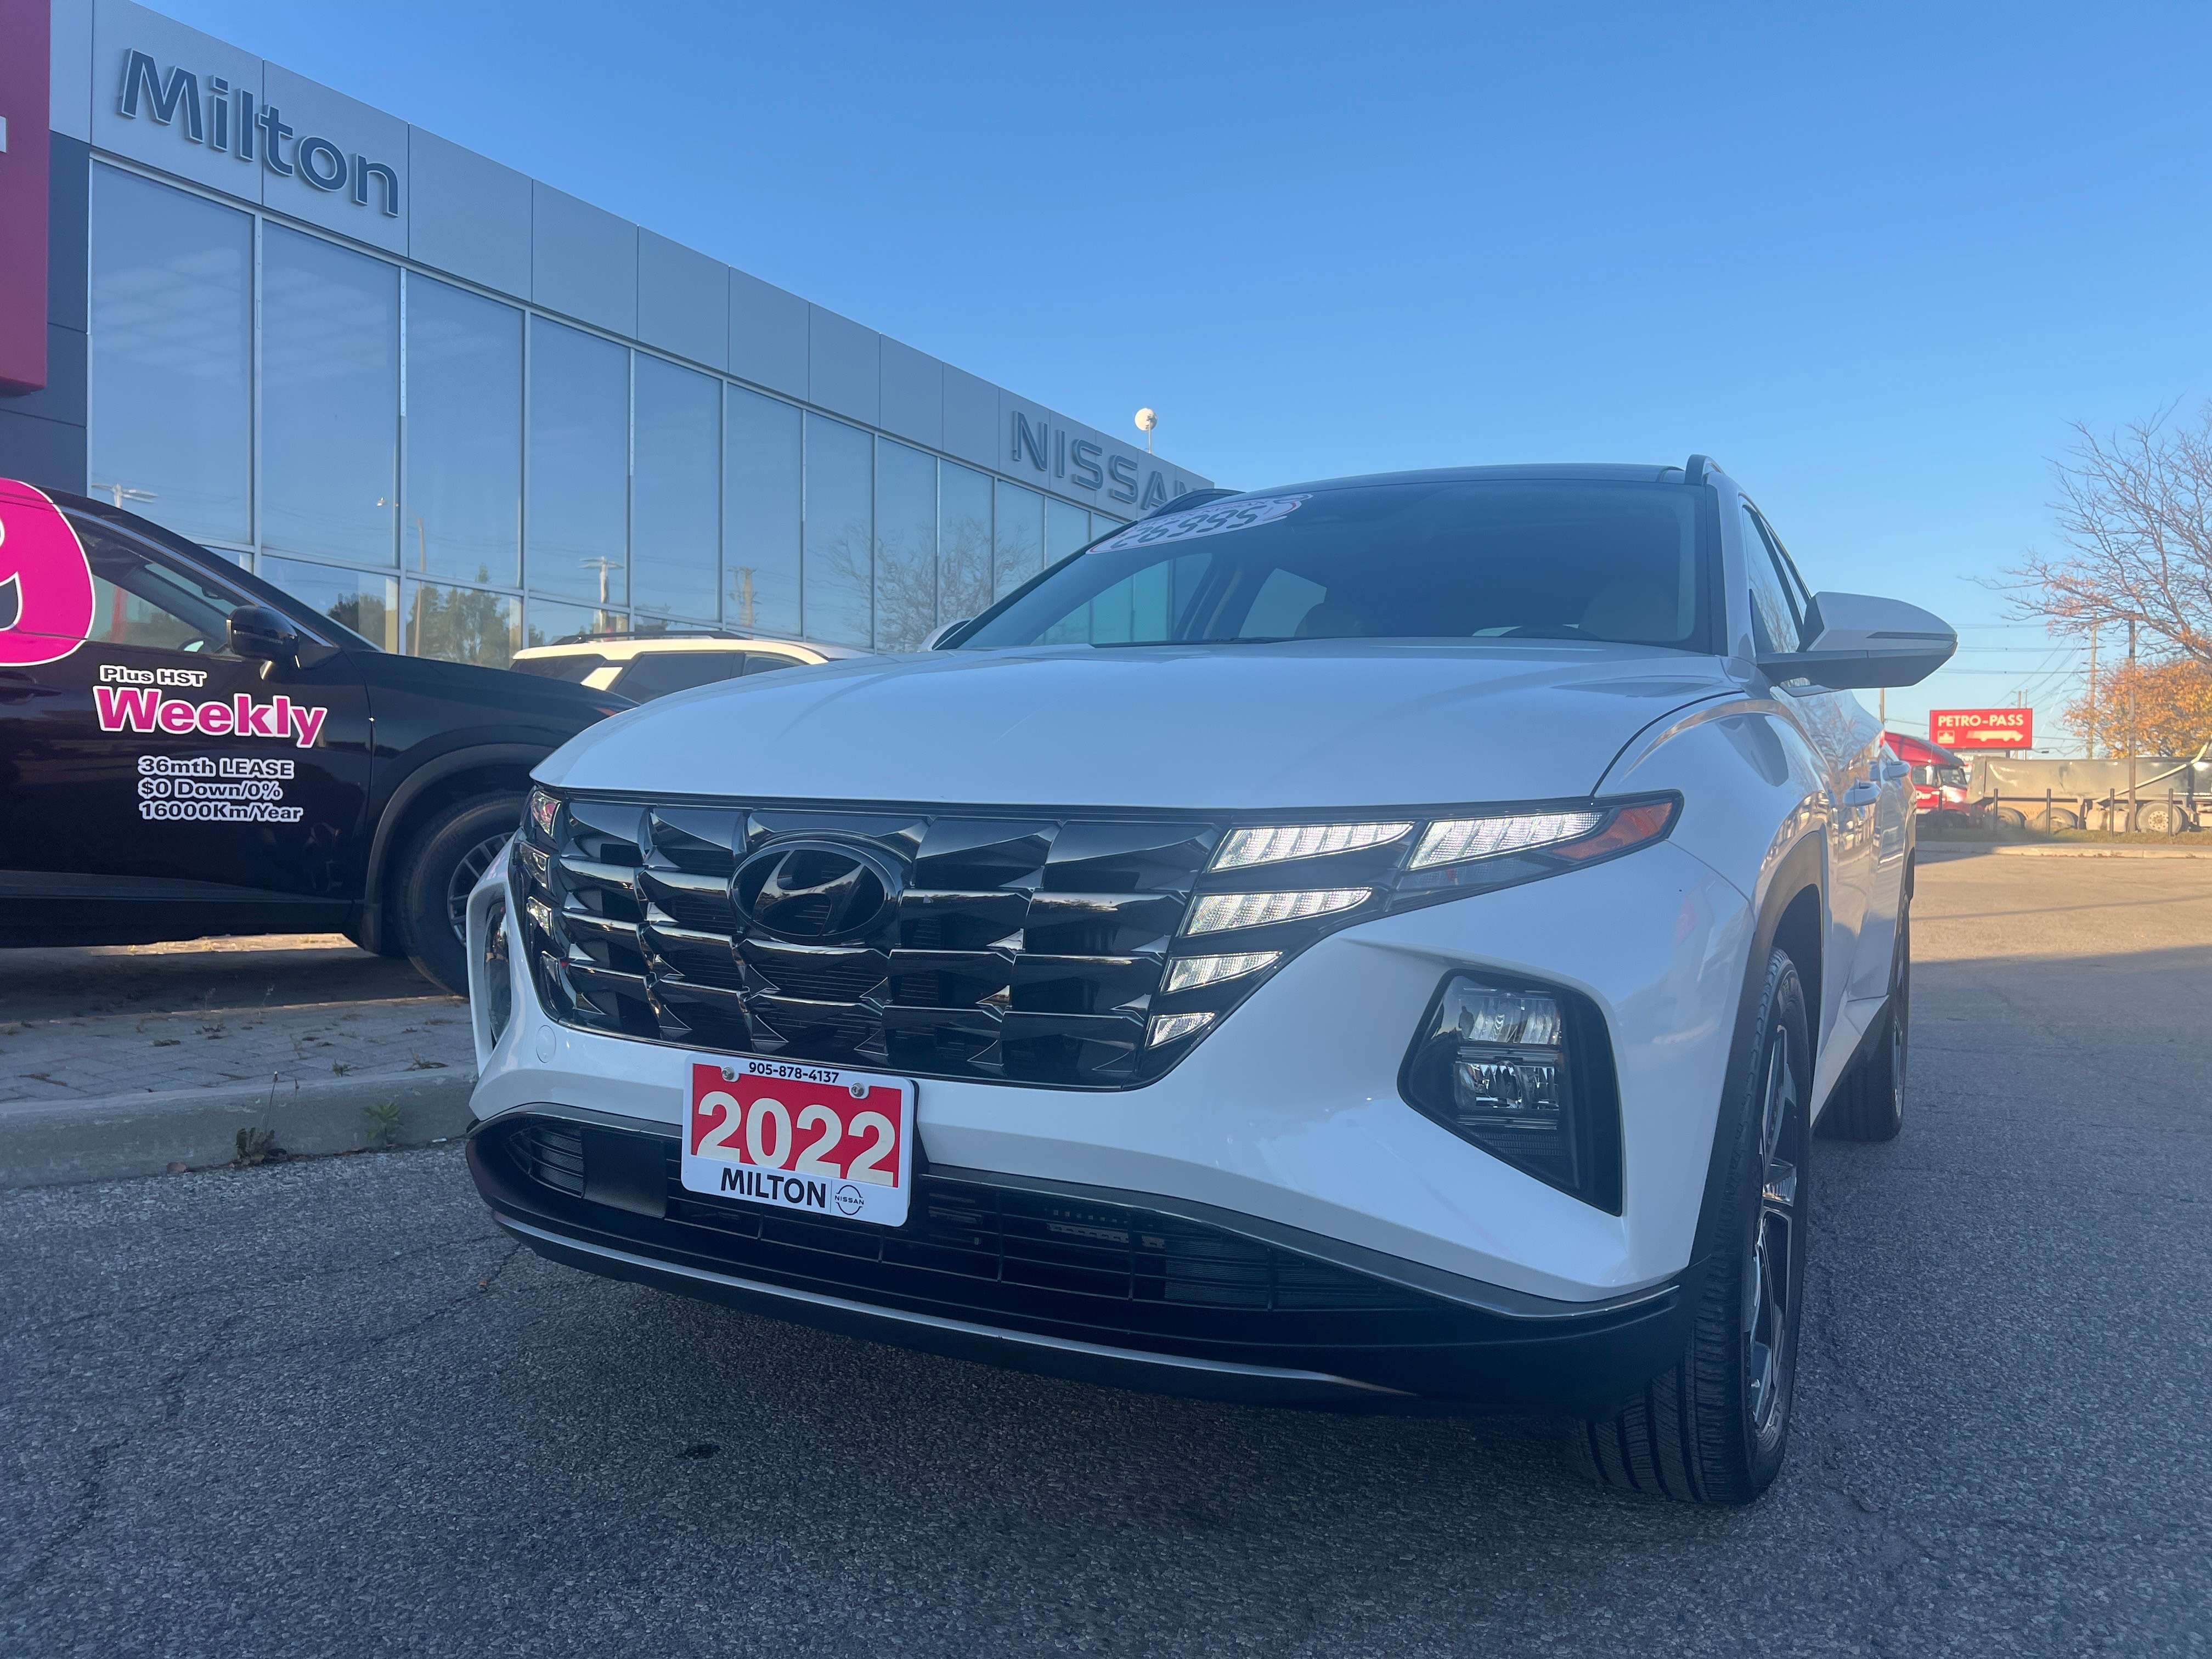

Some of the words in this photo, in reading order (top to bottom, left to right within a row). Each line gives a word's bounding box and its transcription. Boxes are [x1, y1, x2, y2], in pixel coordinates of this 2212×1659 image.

[117, 48, 399, 218] Milton
[99, 665, 155, 684] Plus
[157, 668, 207, 687] HST
[93, 686, 327, 748] Weekly
[1937, 714, 2024, 727] PETRO-PASS
[138, 755, 216, 777] 36mth
[219, 758, 294, 779] LEASE
[138, 778, 172, 799] $0
[174, 779, 284, 801] Down/0%
[138, 801, 303, 822] 16000Km/Year
[748, 1062, 839, 1084] 905-878-4137
[697, 1091, 896, 1187] 2022
[720, 1167, 826, 1208] MILTON
[834, 1195, 865, 1205] NISSAN
